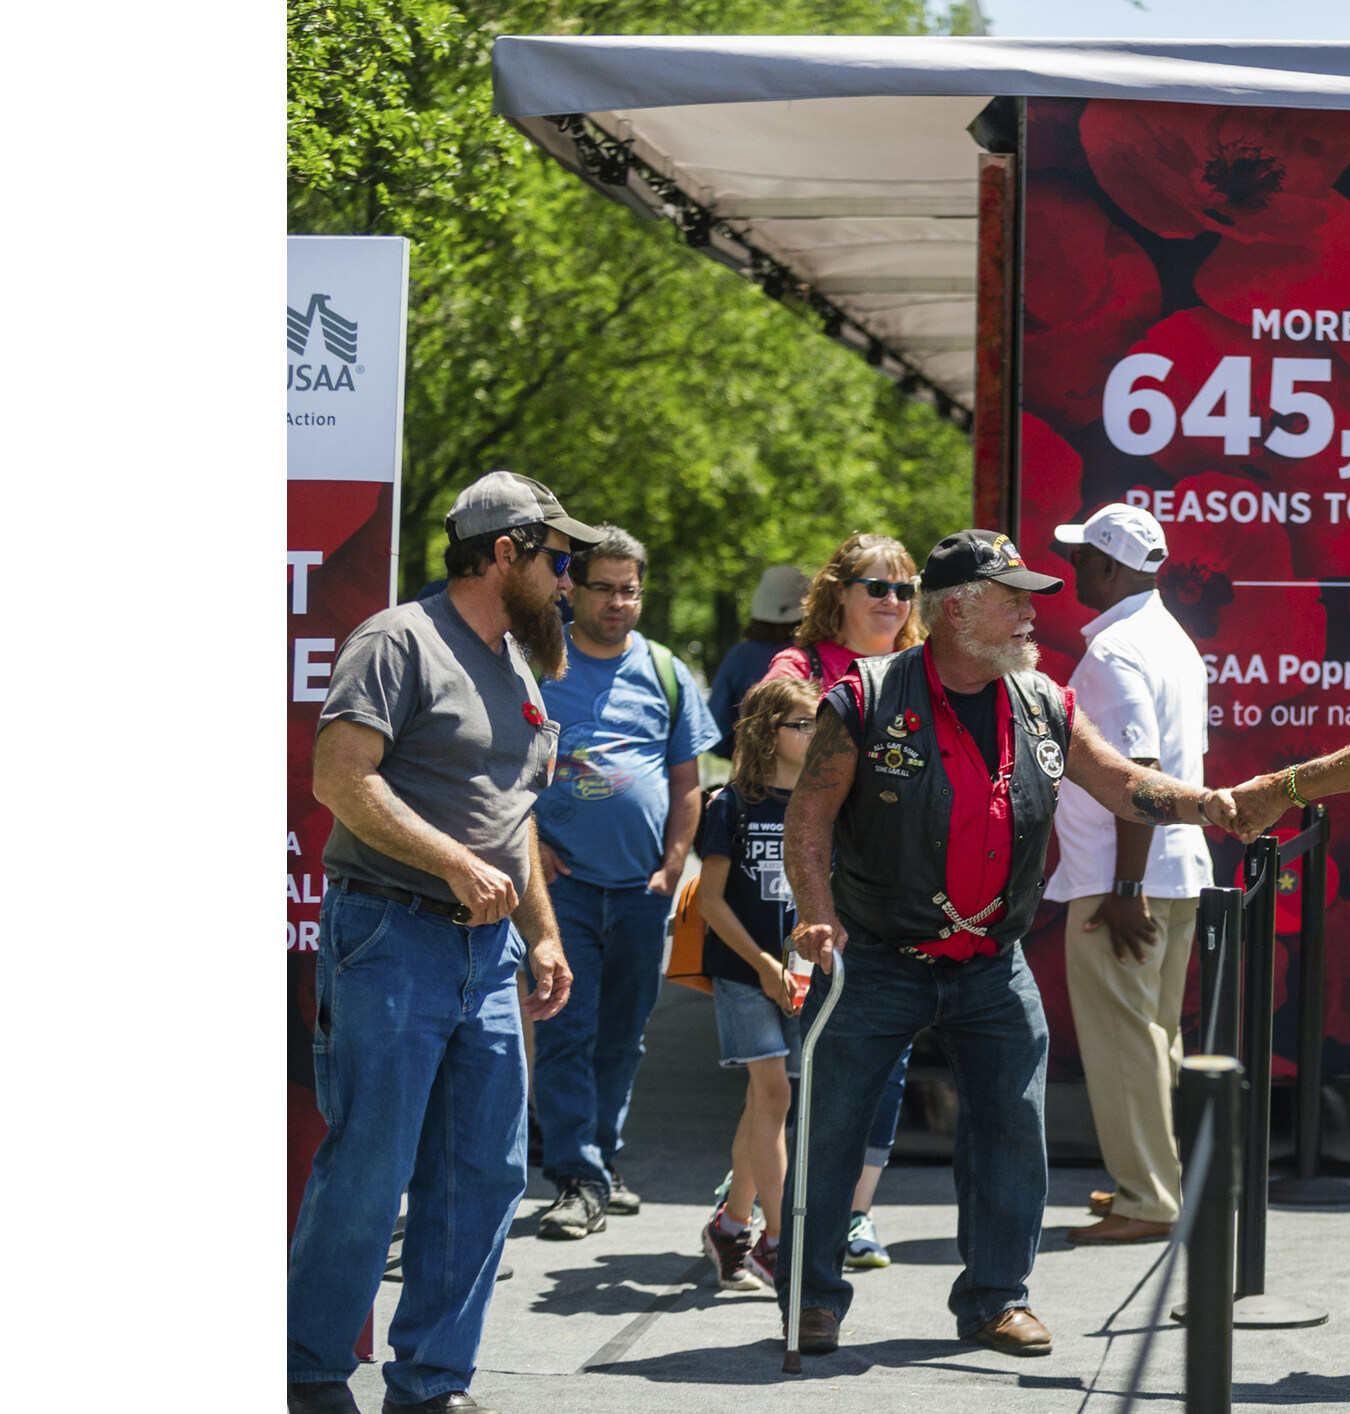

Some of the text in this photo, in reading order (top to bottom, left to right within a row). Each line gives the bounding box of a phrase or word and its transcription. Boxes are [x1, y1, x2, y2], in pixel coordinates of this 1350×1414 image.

[287, 412, 336, 426] Action
[1233, 701, 1262, 726] to
[1270, 704, 1318, 726] our
